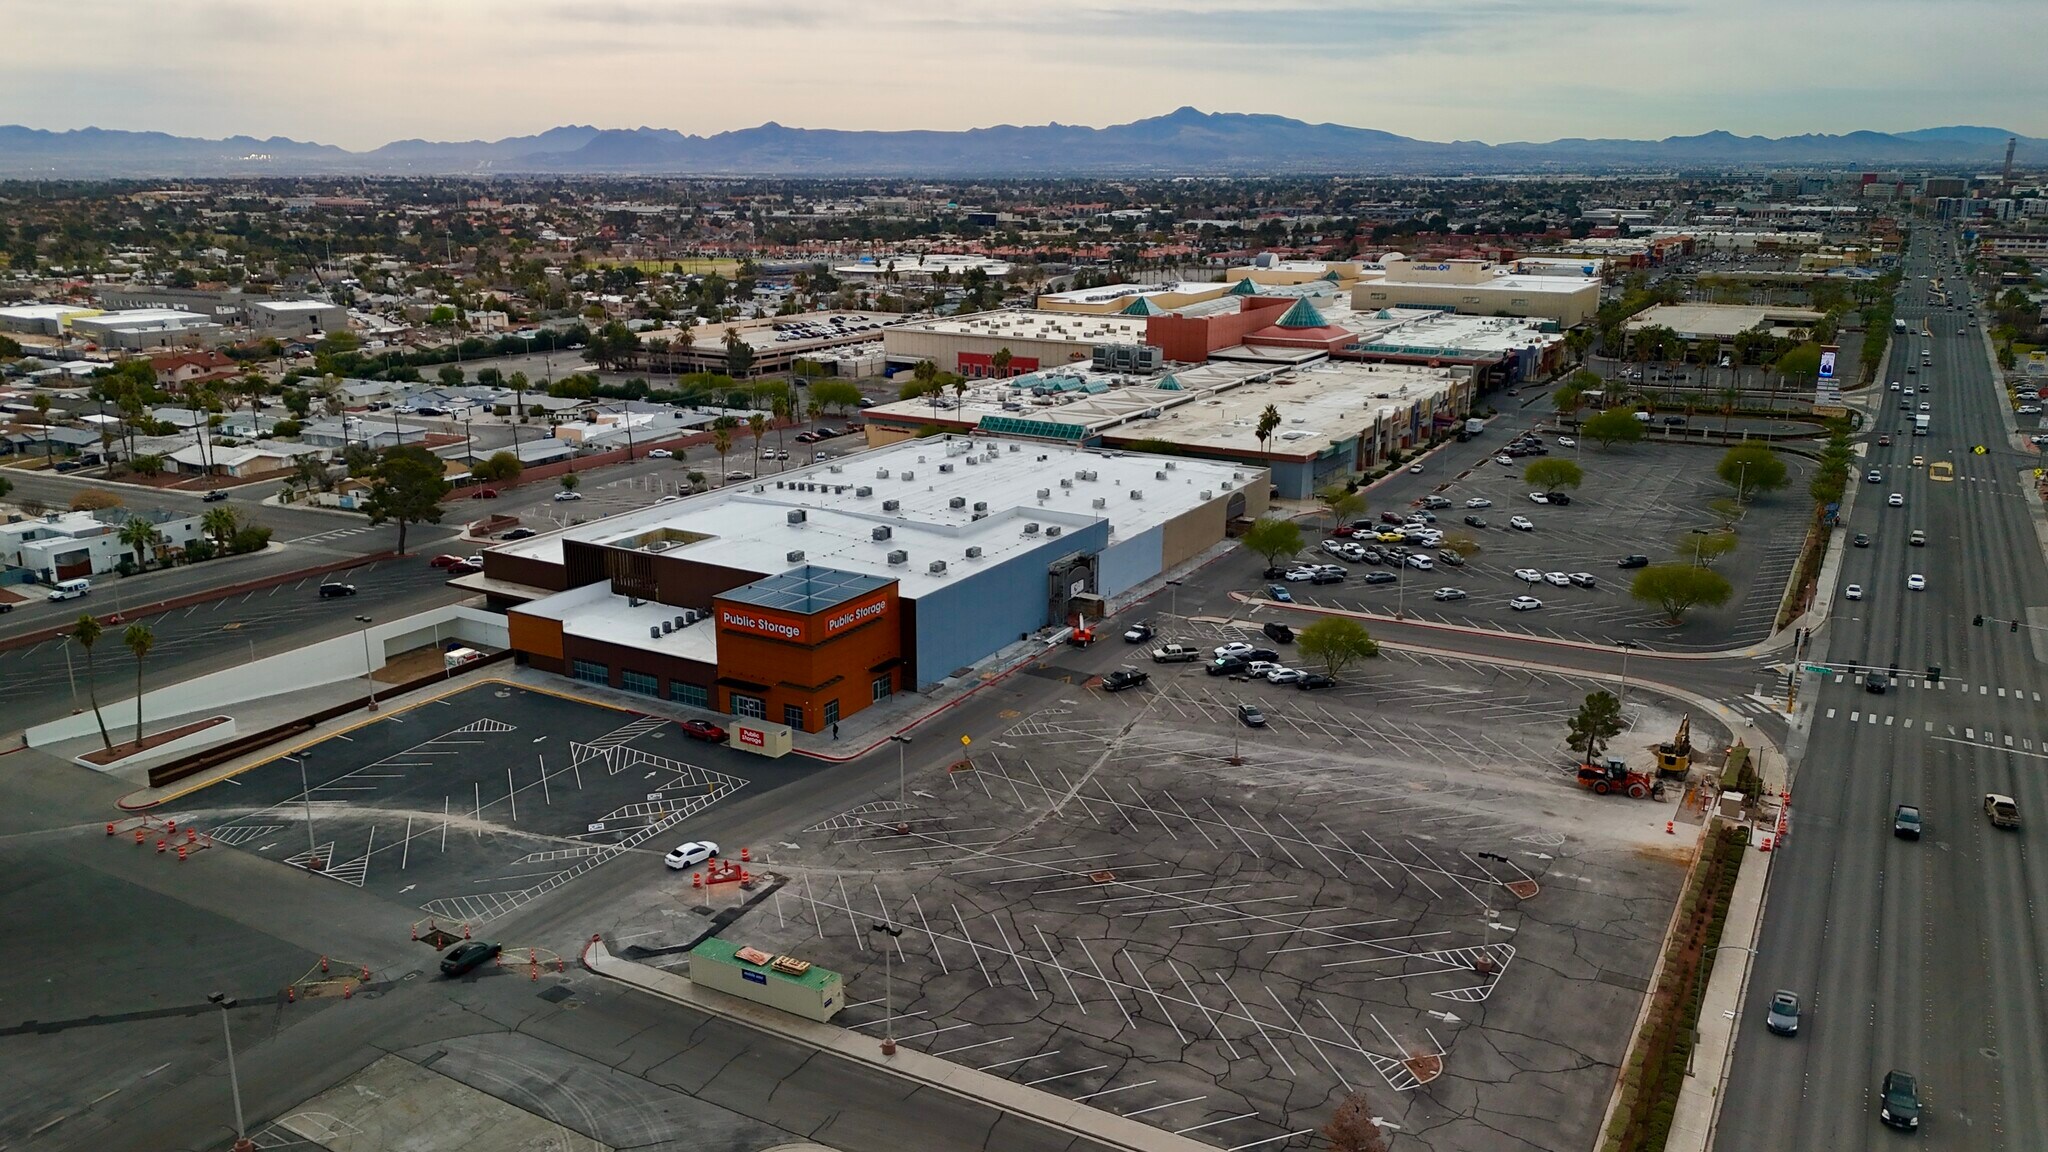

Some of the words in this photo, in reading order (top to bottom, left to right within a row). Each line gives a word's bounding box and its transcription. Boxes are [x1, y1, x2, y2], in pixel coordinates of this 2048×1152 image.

[829, 613, 854, 631] Public
[855, 600, 886, 619] Storage
[723, 612, 756, 628] Public
[758, 618, 800, 638] Storage
[741, 734, 762, 745] Storage
[743, 729, 760, 739] Public
